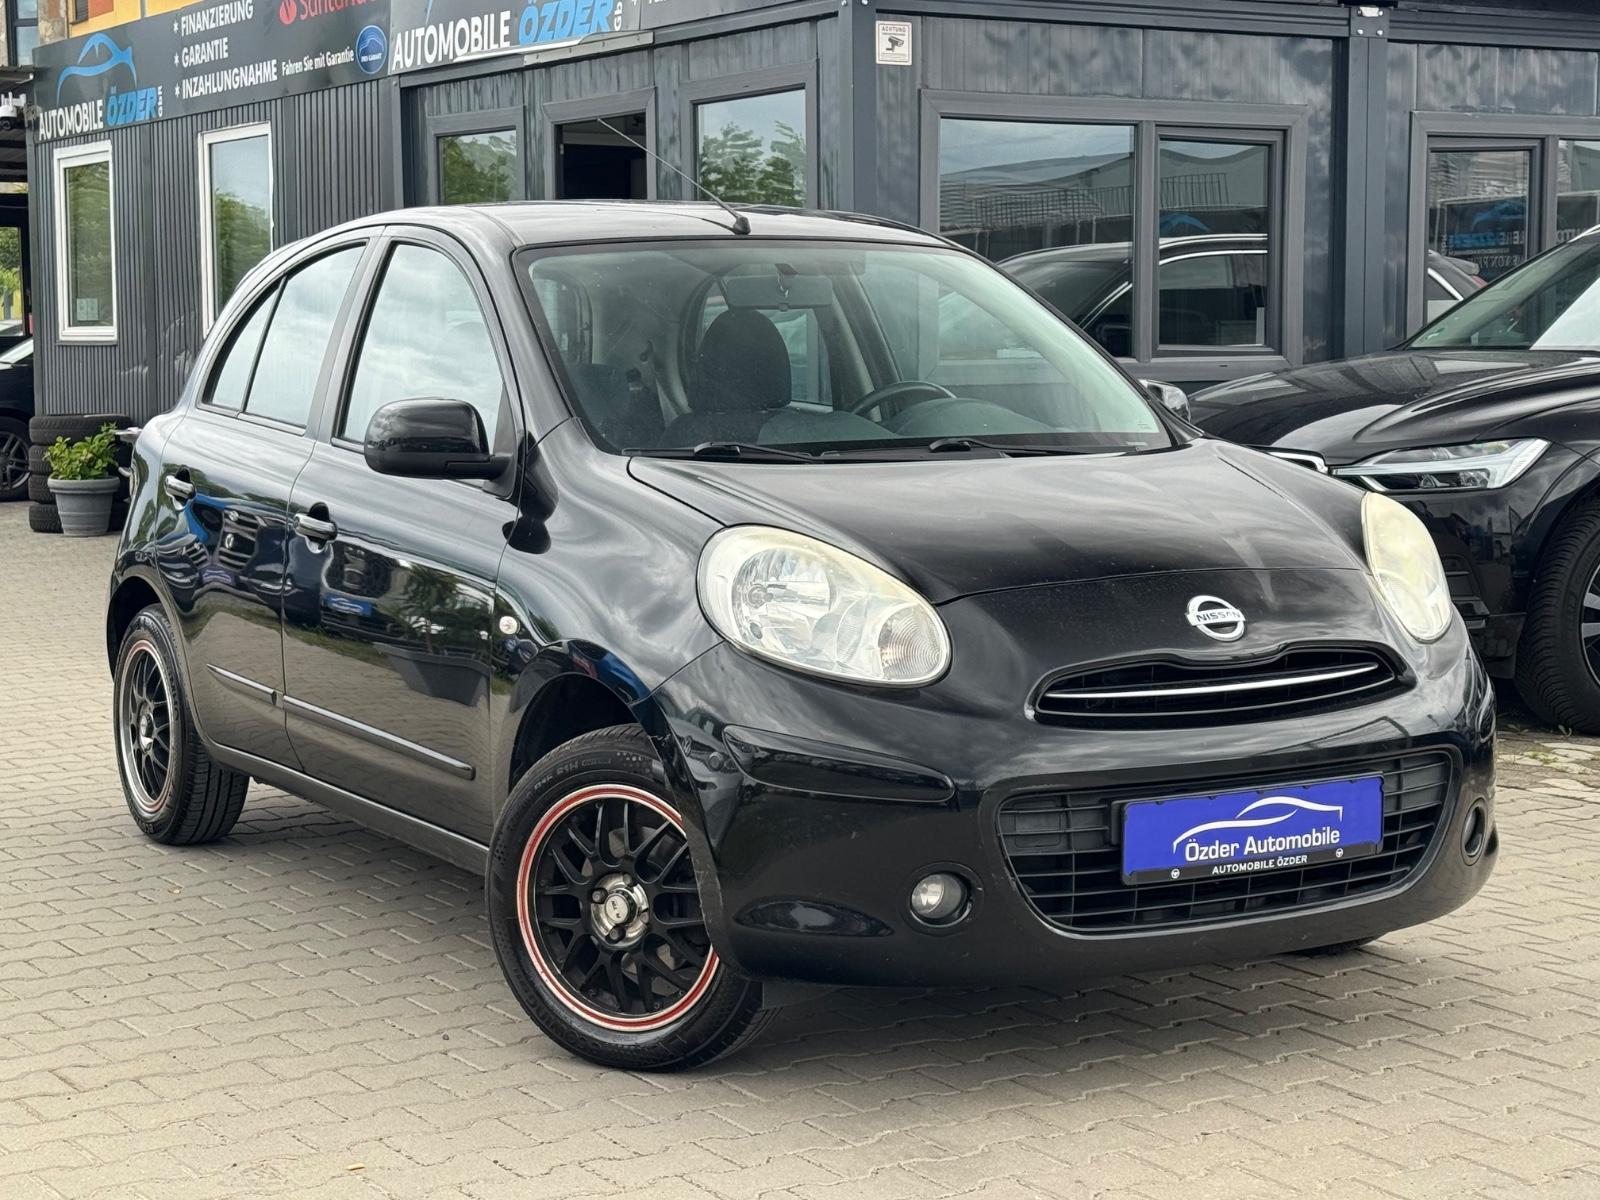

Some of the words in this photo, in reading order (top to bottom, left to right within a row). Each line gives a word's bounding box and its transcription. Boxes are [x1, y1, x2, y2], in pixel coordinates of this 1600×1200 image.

[181, 0, 254, 37] FINANZIERUNG
[391, 10, 511, 71] AUTOMOBILE
[518, 0, 613, 46] ÖZDER
[181, 36, 229, 69] GARANTIE
[281, 59, 304, 76] Fahren
[303, 55, 314, 72] Sie
[314, 51, 326, 69] mit
[325, 46, 355, 67] Garantie
[182, 58, 278, 100] INZAHLUNGNAHME
[38, 99, 104, 141] AUTOMOBILE
[107, 85, 157, 127] ÖZDER
[1185, 839, 1239, 862] Özder
[1243, 826, 1340, 856] Automobile
[1211, 859, 1275, 875] AUTOMOBILE
[1276, 854, 1308, 866] ÖZDER
